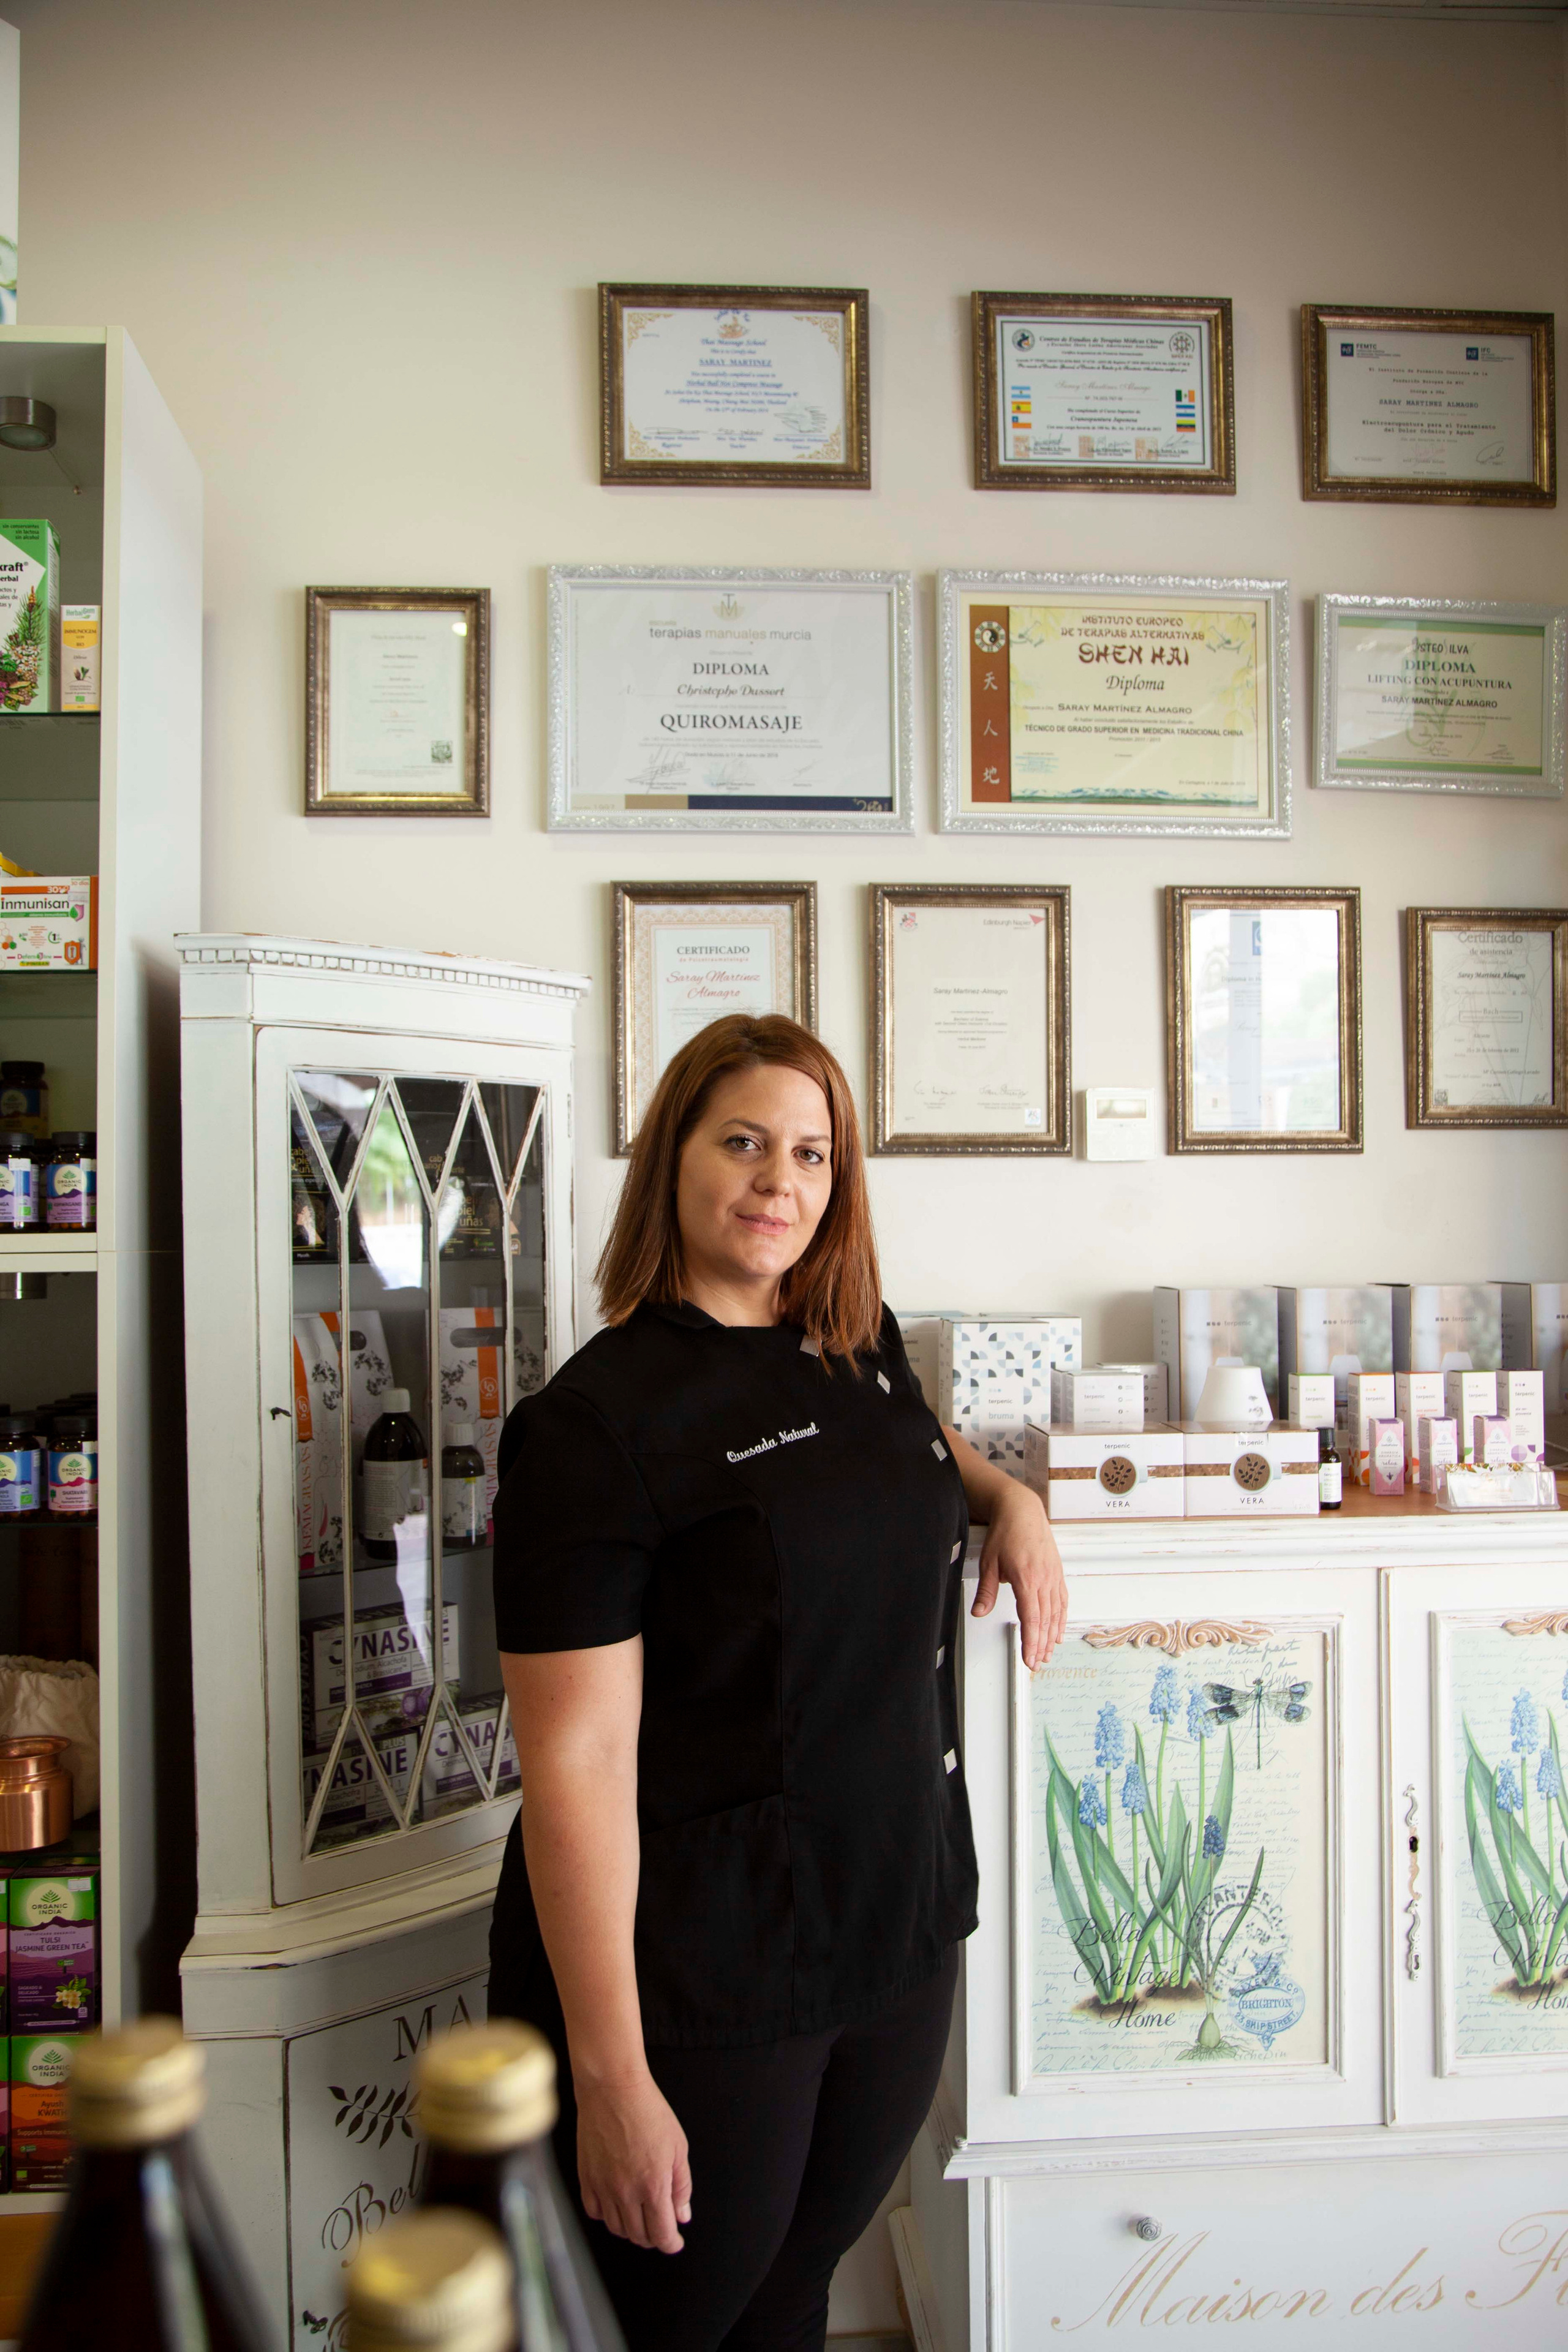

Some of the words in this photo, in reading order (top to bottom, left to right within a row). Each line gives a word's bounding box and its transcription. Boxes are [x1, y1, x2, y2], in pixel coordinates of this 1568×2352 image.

[729, 359, 772, 368] MARTINEZ
[1082, 614, 1133, 625] INSTITUTO
[1136, 616, 1183, 627] EUROPEO
[650, 627, 702, 641] terapias
[704, 628, 767, 641] manuales
[769, 629, 812, 641] murcia
[1061, 627, 1074, 636] DE
[1077, 627, 1127, 638] TERAPIAS
[1129, 629, 1205, 641] ALTERNATIVAS
[1079, 642, 1143, 665] SHEN
[1151, 644, 1189, 666] HAI
[693, 662, 769, 675] DIPLOMA
[1404, 659, 1476, 674] DIPLOMA
[1106, 674, 1165, 696] Diploma
[1368, 674, 1412, 685] LIFTING
[1414, 676, 1437, 687] CON
[1440, 677, 1512, 690] ACUPUNTURA
[1382, 695, 1409, 704] SARAY
[1412, 695, 1454, 707] MARTÍNEZ
[1455, 699, 1498, 709] ALMAGRO
[660, 713, 803, 734] QUIROMASAJE
[1142, 727, 1175, 736] MEDICINA
[1177, 728, 1221, 736] TRADICIONAL
[983, 918, 1012, 927] Edinburgh
[1458, 931, 1523, 944] Certificado
[677, 946, 750, 955] CERTIFICADO
[666, 970, 704, 985] Saray
[1457, 971, 1474, 980] Saray
[687, 986, 741, 1000] Almagro
[933, 987, 952, 996] Saray
[726, 1437, 778, 1463] Quesada
[779, 1421, 820, 1445] Natural
[301, 1446, 312, 1550] KEMAGRASAS
[382, 1738, 405, 1749] PLUS
[1477, 1894, 1561, 1938] Bella
[1057, 1911, 1145, 1956] Bella
[1074, 1952, 1193, 1997] Vintage
[1241, 1997, 1292, 2009] BRIGHTON
[1100, 1997, 1177, 2029] Home
[1050, 2230, 1333, 2332] Maison
[1349, 2246, 1447, 2317] des
